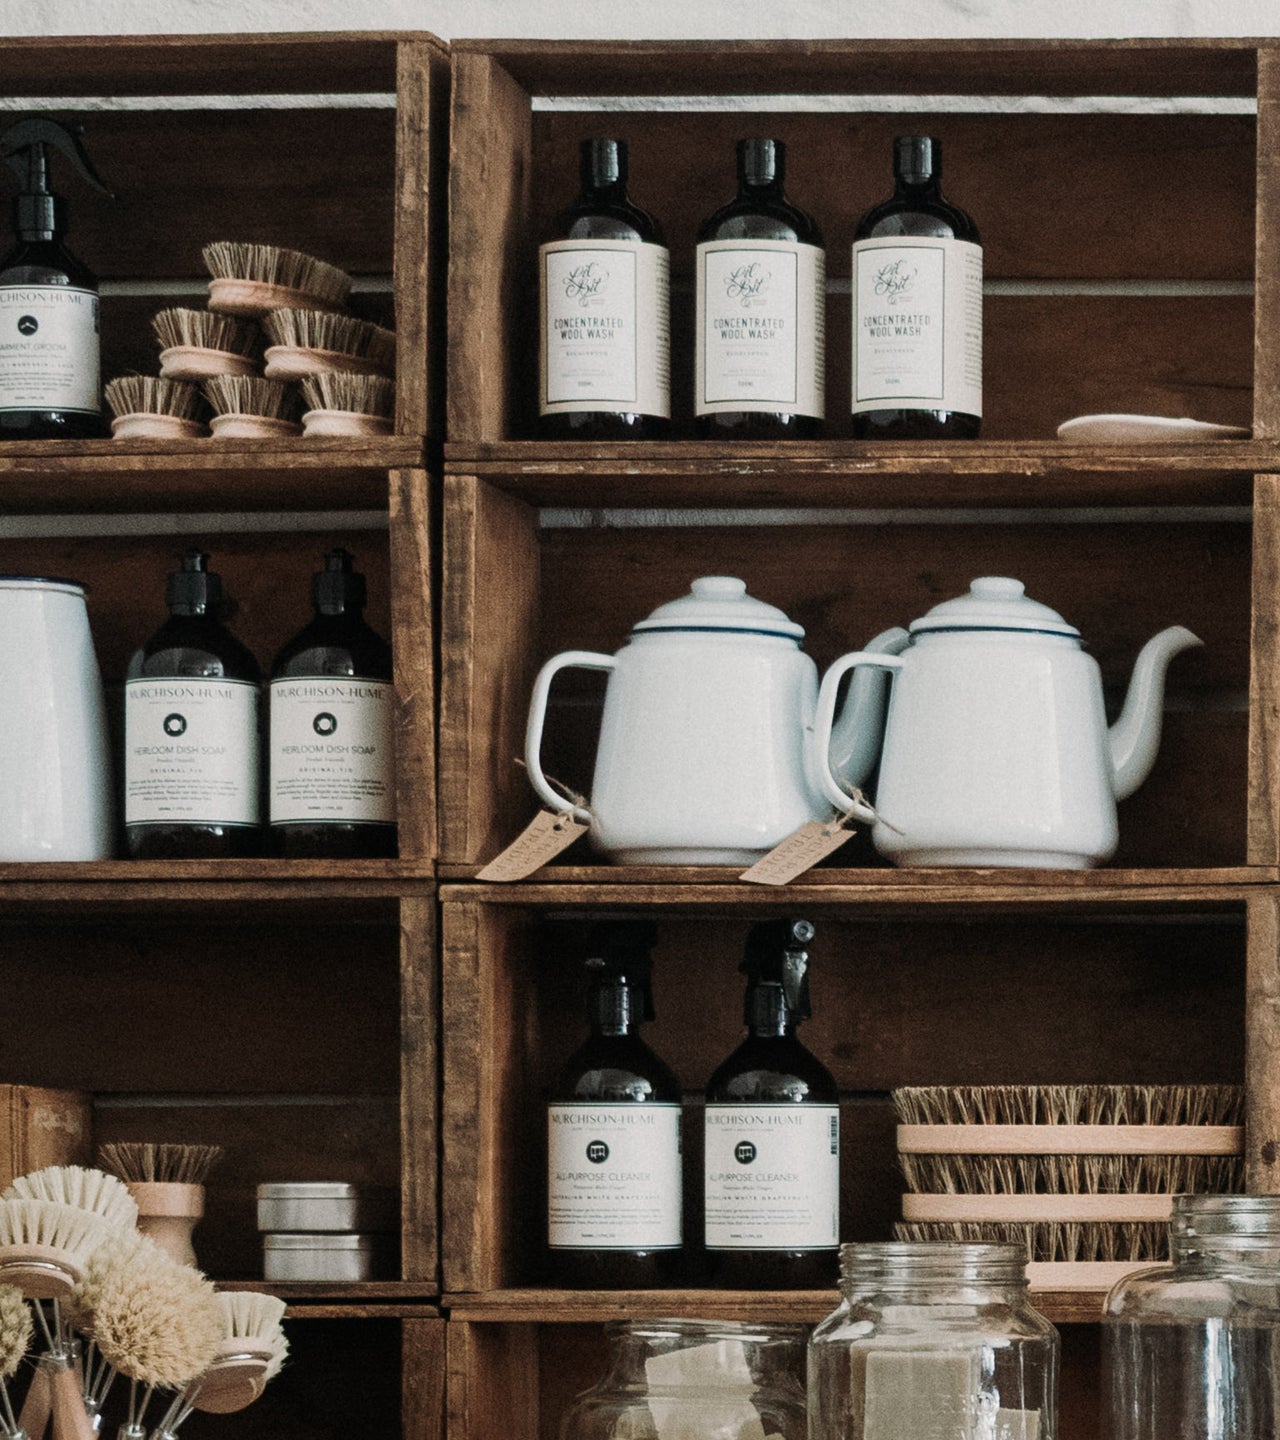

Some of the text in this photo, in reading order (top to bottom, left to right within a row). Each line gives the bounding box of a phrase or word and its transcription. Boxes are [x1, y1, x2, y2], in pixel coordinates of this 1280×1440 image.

[554, 317, 624, 329] CONCENTRATED
[713, 317, 785, 329] CONCENTRATED
[863, 314, 931, 327] CONCENTRATED
[560, 329, 614, 340] WOOL WASH
[720, 330, 776, 340] WOOL WASH
[869, 326, 921, 338] WOOL WASH
[176, 746, 199, 754] DISH
[326, 745, 349, 754] DISH
[351, 746, 376, 755] SOAP
[755, 1173, 799, 1182] CLEANER
